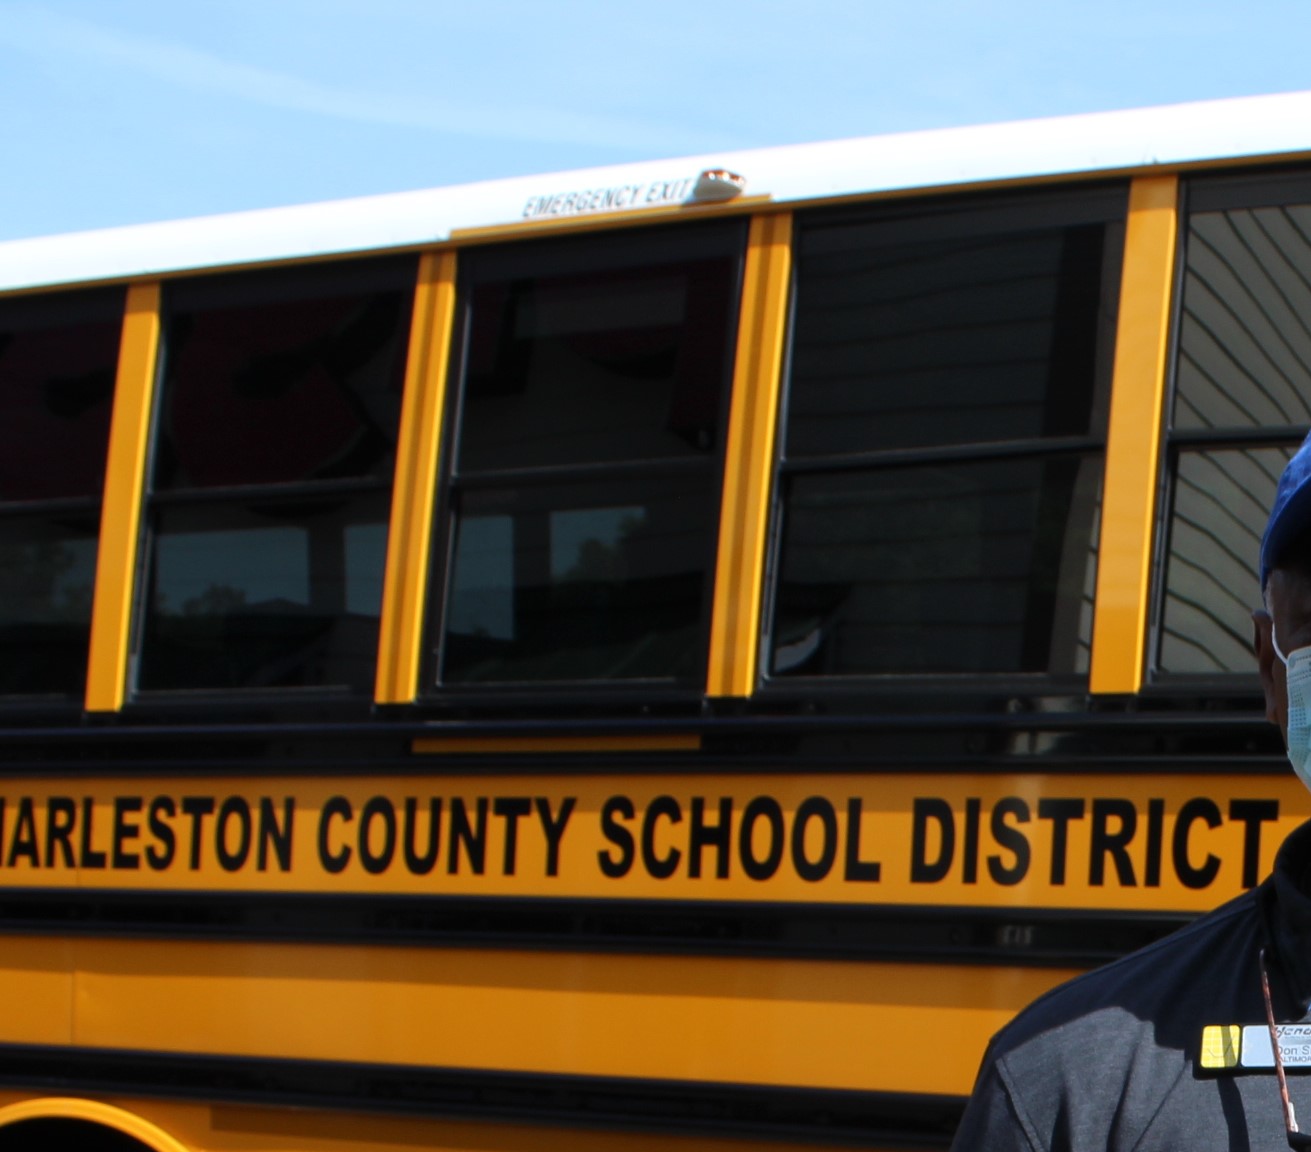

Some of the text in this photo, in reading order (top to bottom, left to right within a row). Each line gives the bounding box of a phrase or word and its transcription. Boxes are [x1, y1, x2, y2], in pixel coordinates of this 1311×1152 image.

[522, 178, 692, 217] EMERGENCY EXIT
[0, 795, 1280, 890] ARLESTON COUNTY SCHOOL DISTRICT
